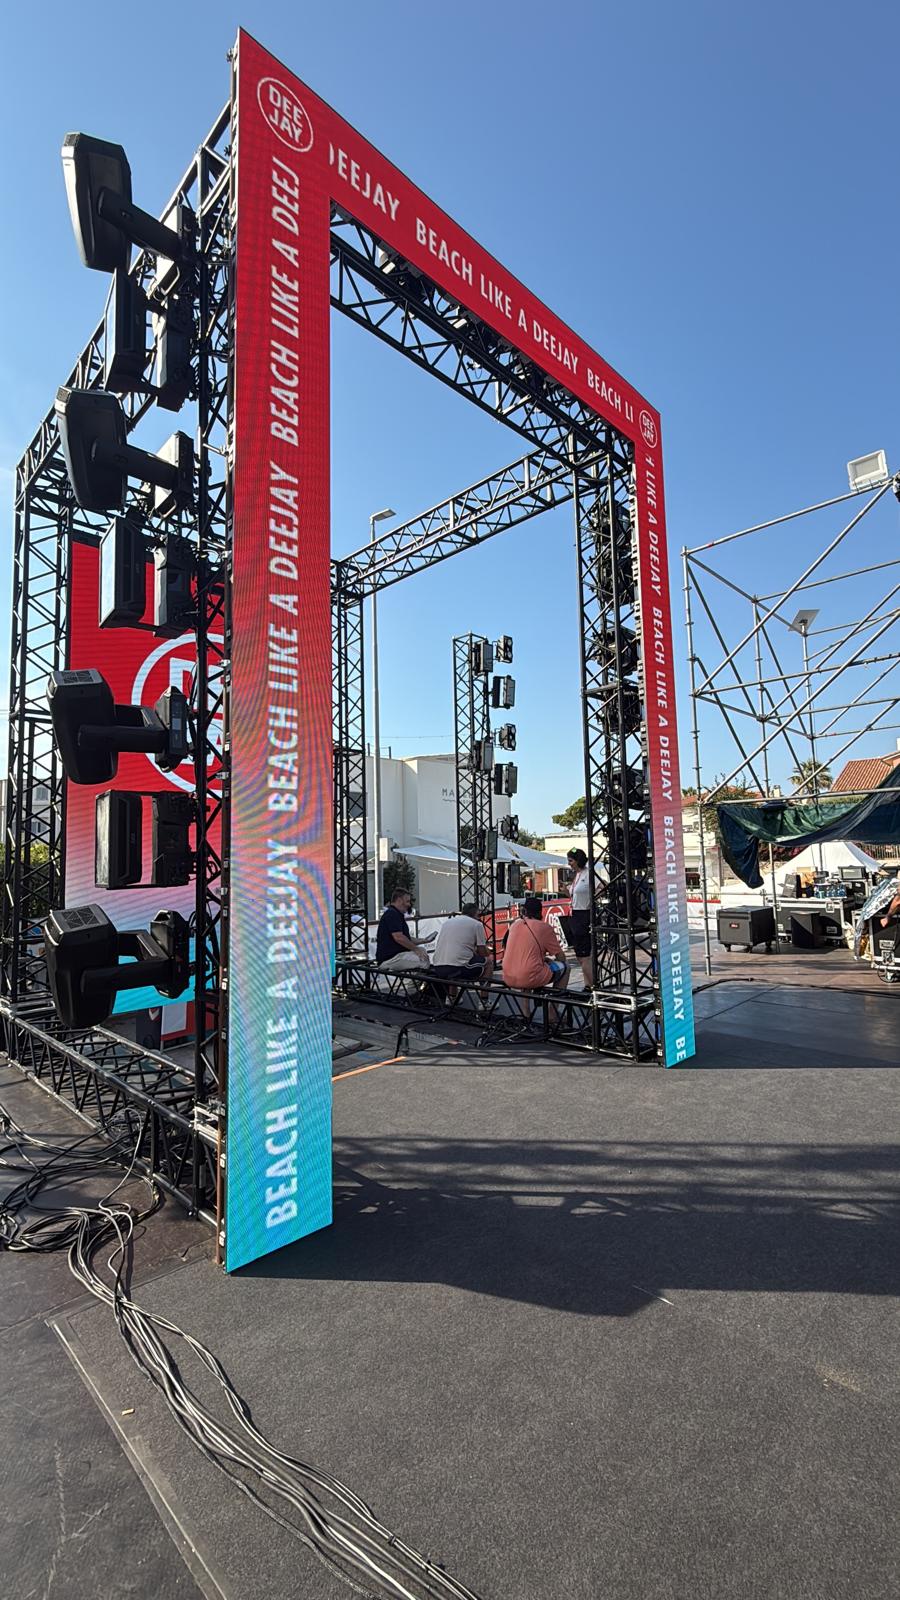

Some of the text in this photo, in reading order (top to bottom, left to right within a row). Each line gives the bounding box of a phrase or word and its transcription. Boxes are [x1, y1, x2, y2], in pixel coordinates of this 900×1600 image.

[268, 84, 303, 127] DEE
[268, 109, 304, 144] JAY
[416, 217, 472, 286] BEACH
[480, 273, 512, 319] LIKE
[517, 308, 527, 333] A
[533, 320, 579, 375] DEEJAY
[587, 368, 621, 414] BEACH
[625, 400, 634, 424] LI
[646, 470, 657, 509] LIKE
[648, 511, 658, 524] A
[648, 530, 662, 598] DEEJAY
[652, 608, 665, 665] BEACH
[265, 156, 300, 1230] BEACH LIKE A DEEJAY BEACH LIKE A DEEJAY BEACH LIKE A DEEJ
[656, 668, 668, 711] LIKE
[658, 714, 669, 728] A
[658, 735, 673, 802] DEEJAY
[663, 814, 676, 876] BEACH
[667, 883, 679, 924] LIKE
[669, 931, 680, 945] A
[669, 952, 685, 1021] DEEJAY
[674, 1036, 687, 1062] BE
